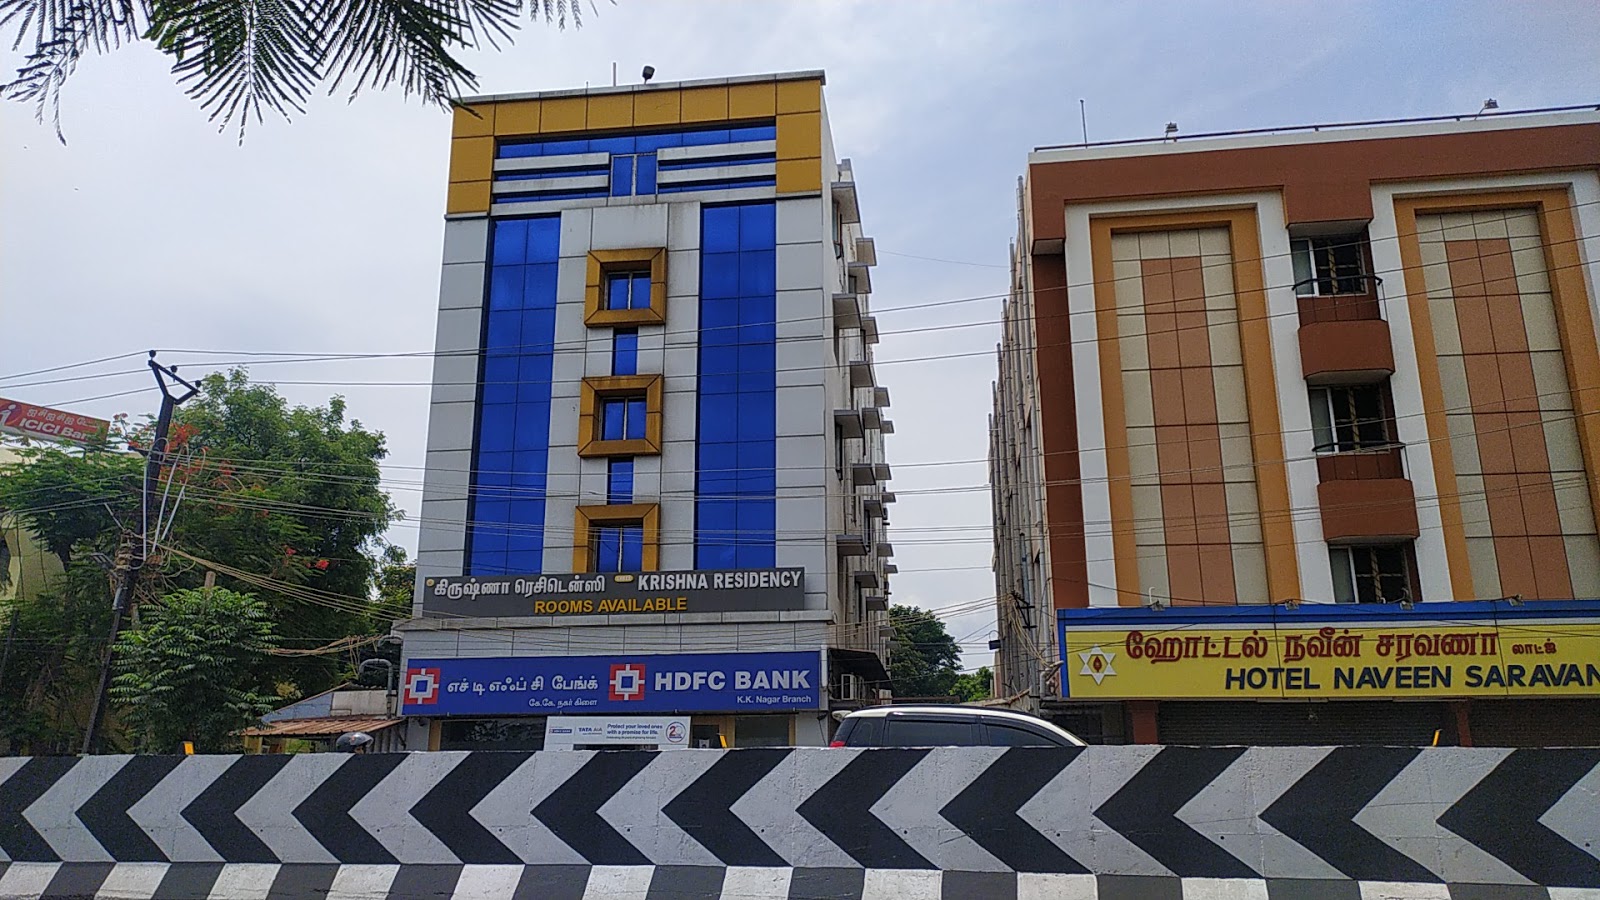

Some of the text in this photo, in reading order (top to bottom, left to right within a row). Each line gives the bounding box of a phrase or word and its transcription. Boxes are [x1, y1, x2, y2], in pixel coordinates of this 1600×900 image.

[19, 418, 60, 434] ICICI
[434, 578, 510, 600] கிருஷ்ணா
[637, 571, 802, 591] KRISHNA RESIDENCY
[534, 597, 688, 613] ROOMS AVAILABLE
[1125, 630, 1268, 664] ஹோட்டல்
[1284, 627, 1363, 663] நவீன்
[1376, 632, 1499, 663] சரவணா
[654, 670, 811, 691] HDFC BANK
[1225, 667, 1320, 690] HOTEL
[1334, 665, 1451, 689] NAVEEN
[737, 695, 811, 704] K.K. Nagar Branch
